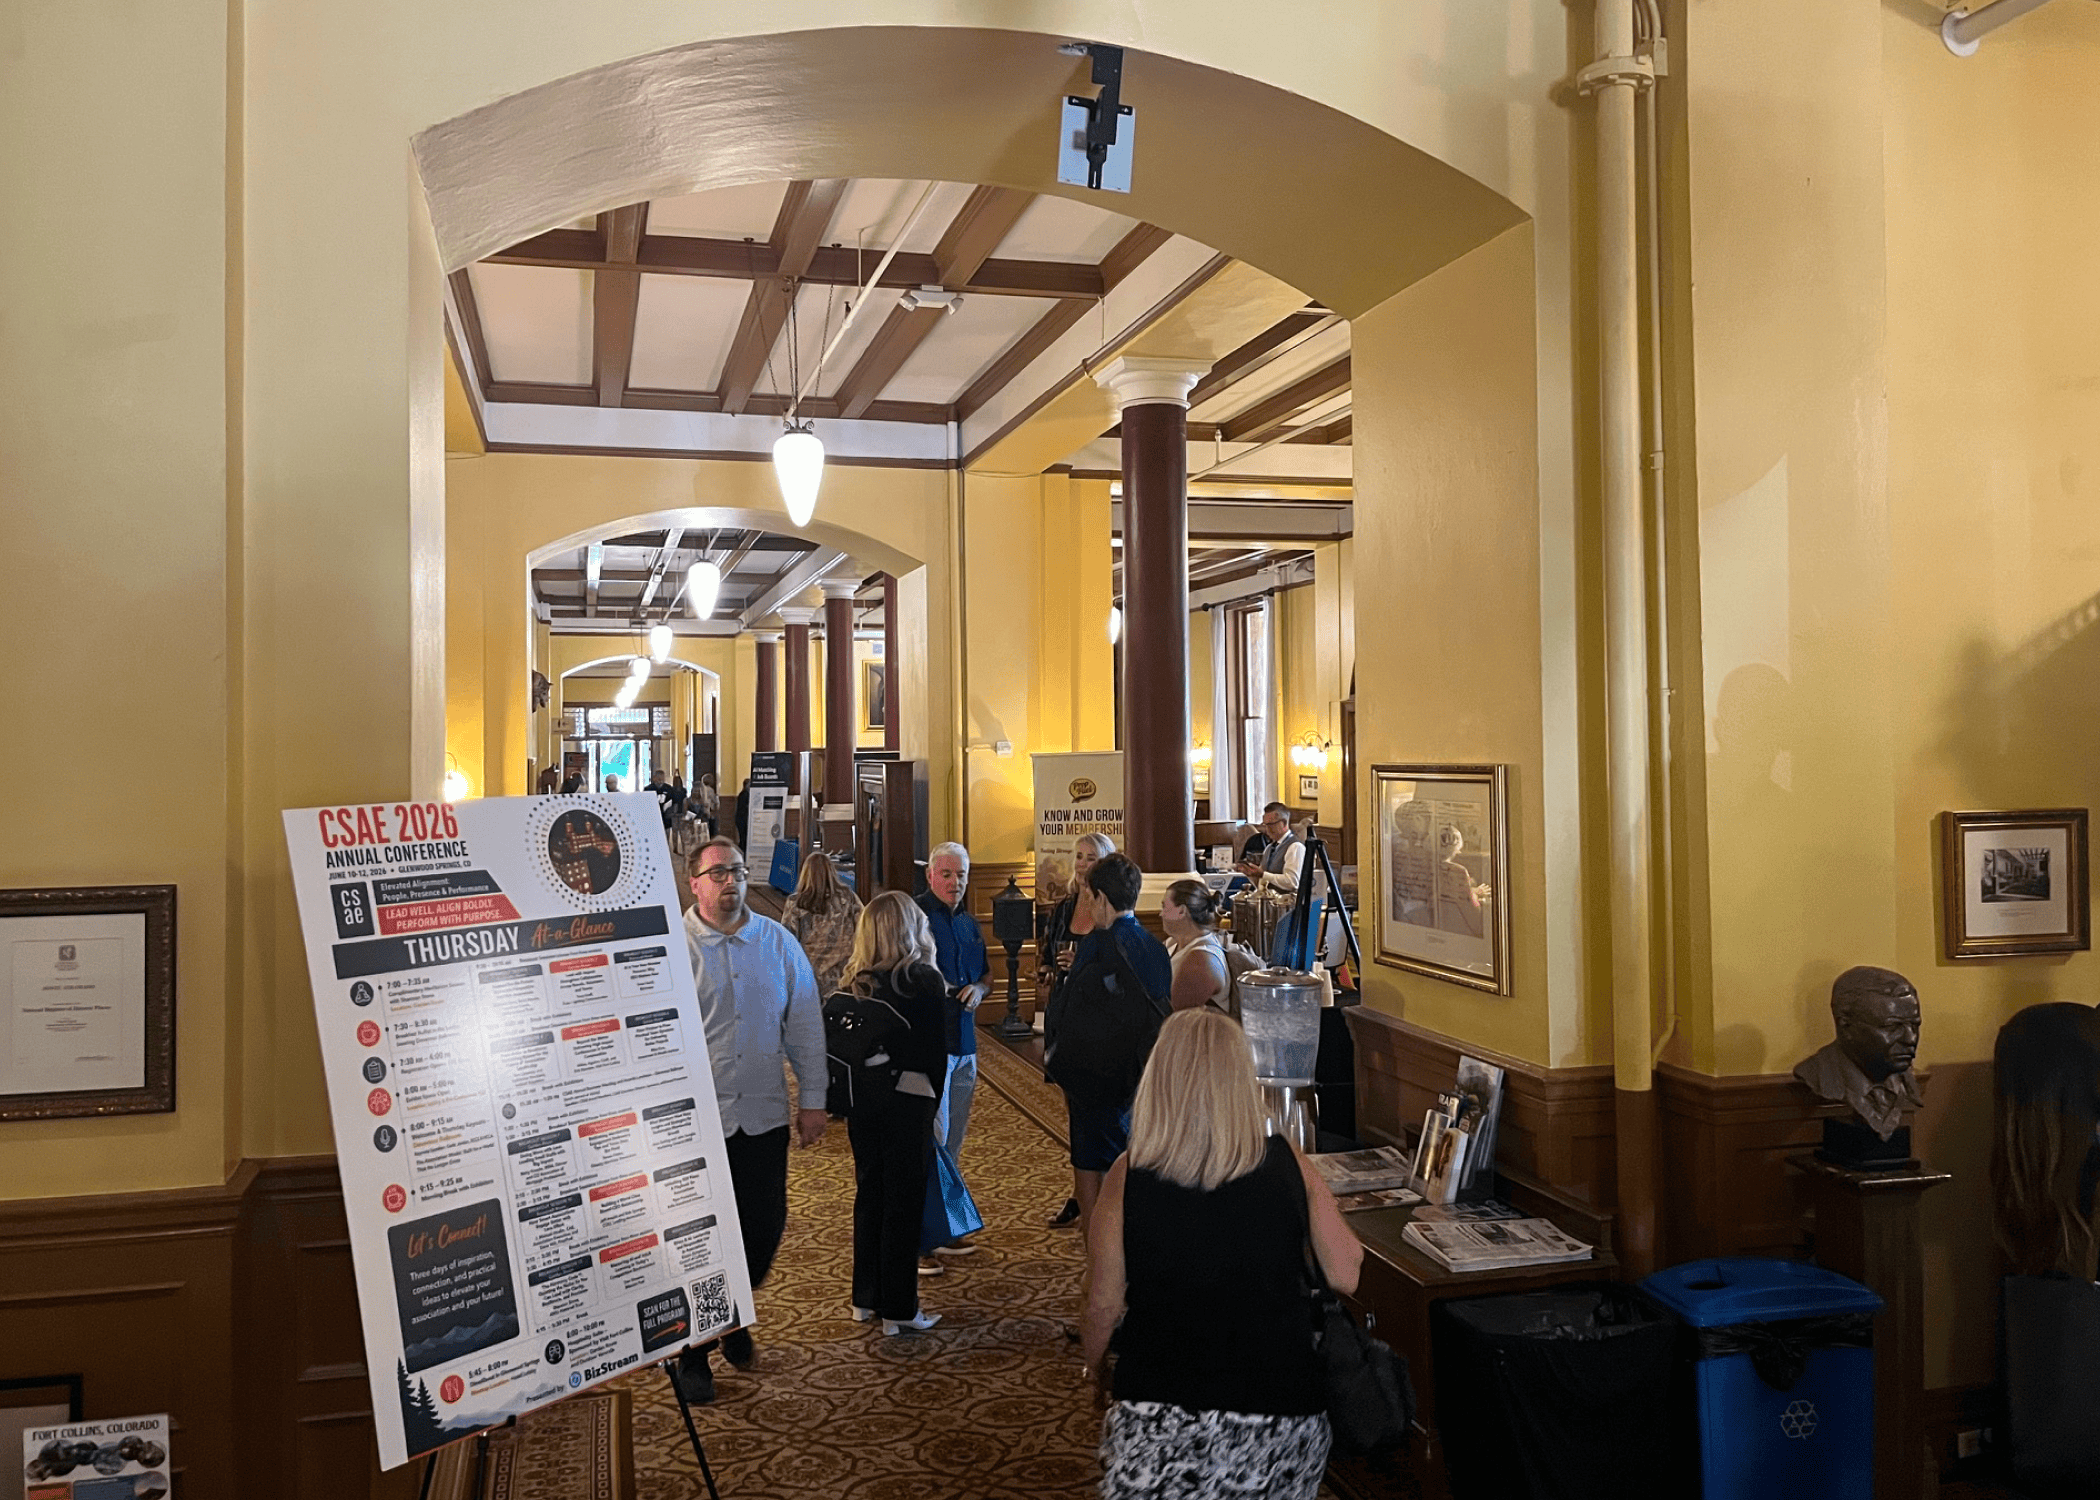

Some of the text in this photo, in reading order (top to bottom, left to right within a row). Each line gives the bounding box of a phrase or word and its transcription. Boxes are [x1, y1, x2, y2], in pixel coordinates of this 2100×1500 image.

[319, 801, 458, 847] CSAE 2026
[1044, 809, 1124, 821] KNOW AND GROW
[1040, 823, 1125, 835] YOUR MEMBERSHI
[326, 841, 467, 868] ANNUAL CONFERENCE
[328, 871, 346, 881] JUNE
[347, 869, 369, 878] 10-12,
[398, 863, 434, 873] GLENWOOD
[380, 881, 411, 891] Elevated
[409, 890, 441, 899] Presence
[441, 887, 448, 895] &
[447, 885, 489, 896] Performance
[344, 907, 364, 925] ae
[386, 908, 408, 920] LEAD
[409, 905, 435, 916] WELL.
[436, 902, 461, 914] ALIGN
[396, 909, 503, 929] PERFORM WITH PURPOSE.
[404, 916, 615, 964] THURSDAY At-a-Glance
[386, 980, 402, 989] 7:00
[410, 1121, 425, 1132] 8:00
[419, 1182, 434, 1193] 9:15
[409, 1270, 431, 1281] Three
[431, 1264, 449, 1275] days
[448, 1259, 457, 1270] of
[454, 1270, 468, 1283] and
[467, 1262, 496, 1280] practical
[422, 1279, 491, 1306] ideas to elevate your
[411, 1306, 451, 1324] association
[451, 1299, 465, 1311] and
[466, 1296, 481, 1308] your
[643, 1295, 681, 1318] SCAN FOR THE
[643, 1318, 657, 1330] FULL
[584, 1354, 639, 1381] BizStream
[32, 1419, 159, 1441] FORT COLLINS, COLORADO
